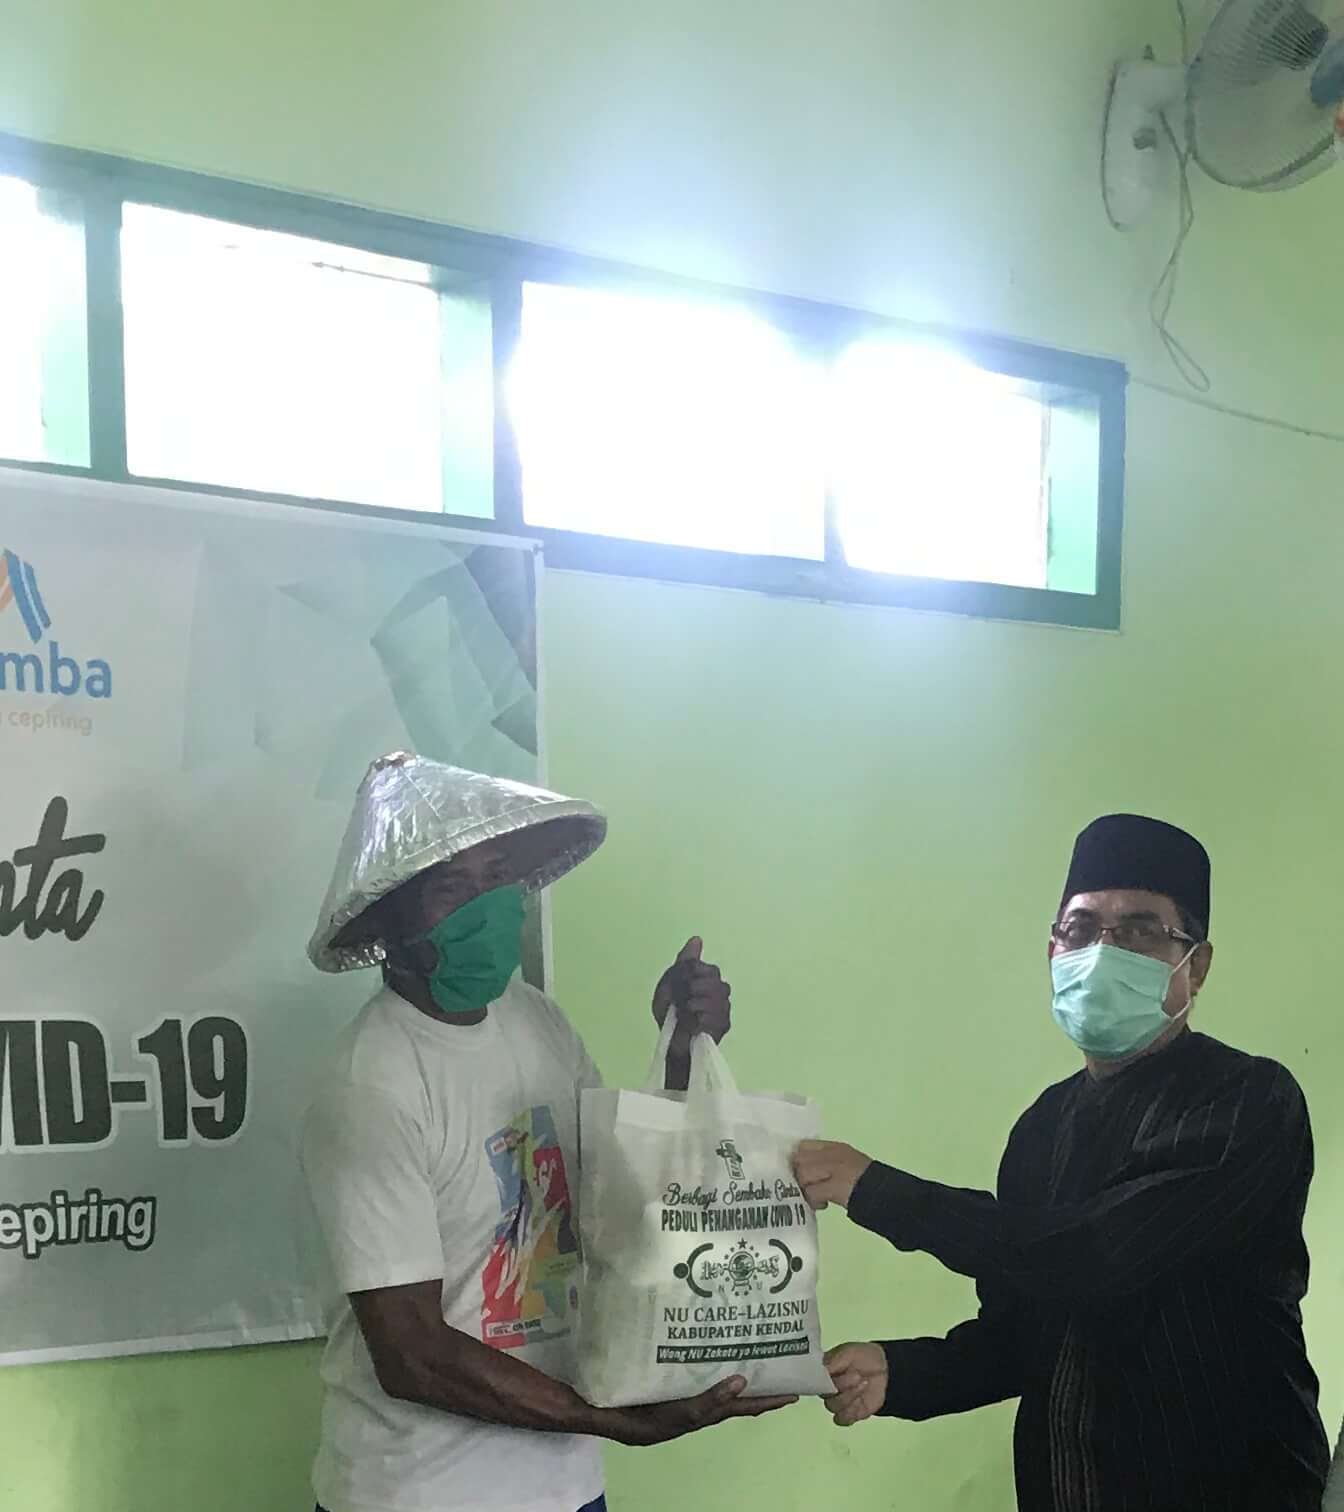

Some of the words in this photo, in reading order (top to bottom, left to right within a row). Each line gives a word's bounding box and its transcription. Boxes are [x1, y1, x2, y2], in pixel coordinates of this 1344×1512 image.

[661, 1208, 698, 1233] PEDULI
[663, 1307, 689, 1323] NU
[667, 1324, 752, 1340] KABUPATEN
[756, 1319, 805, 1337] KENDAL
